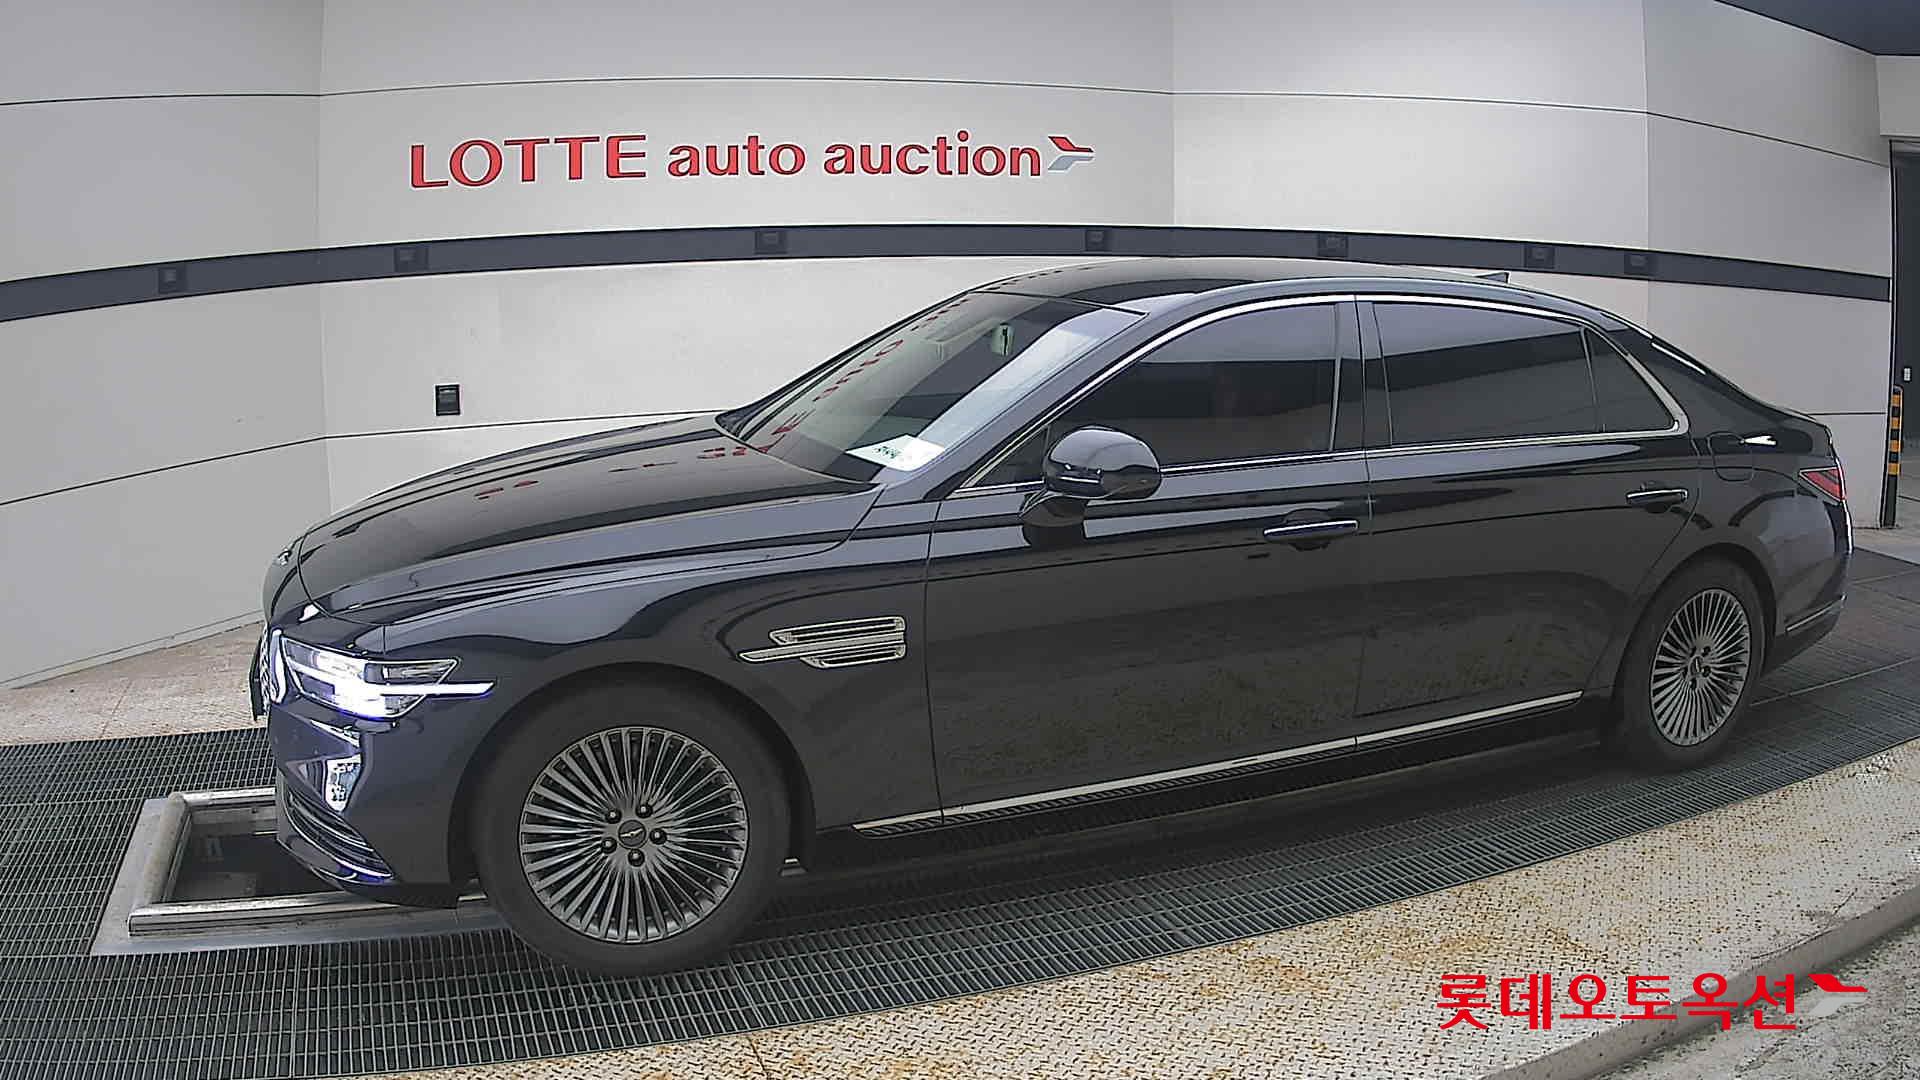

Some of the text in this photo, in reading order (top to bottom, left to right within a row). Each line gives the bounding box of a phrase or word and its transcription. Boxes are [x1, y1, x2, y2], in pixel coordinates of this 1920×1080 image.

[410, 131, 1042, 188] LOTTE auto auction
